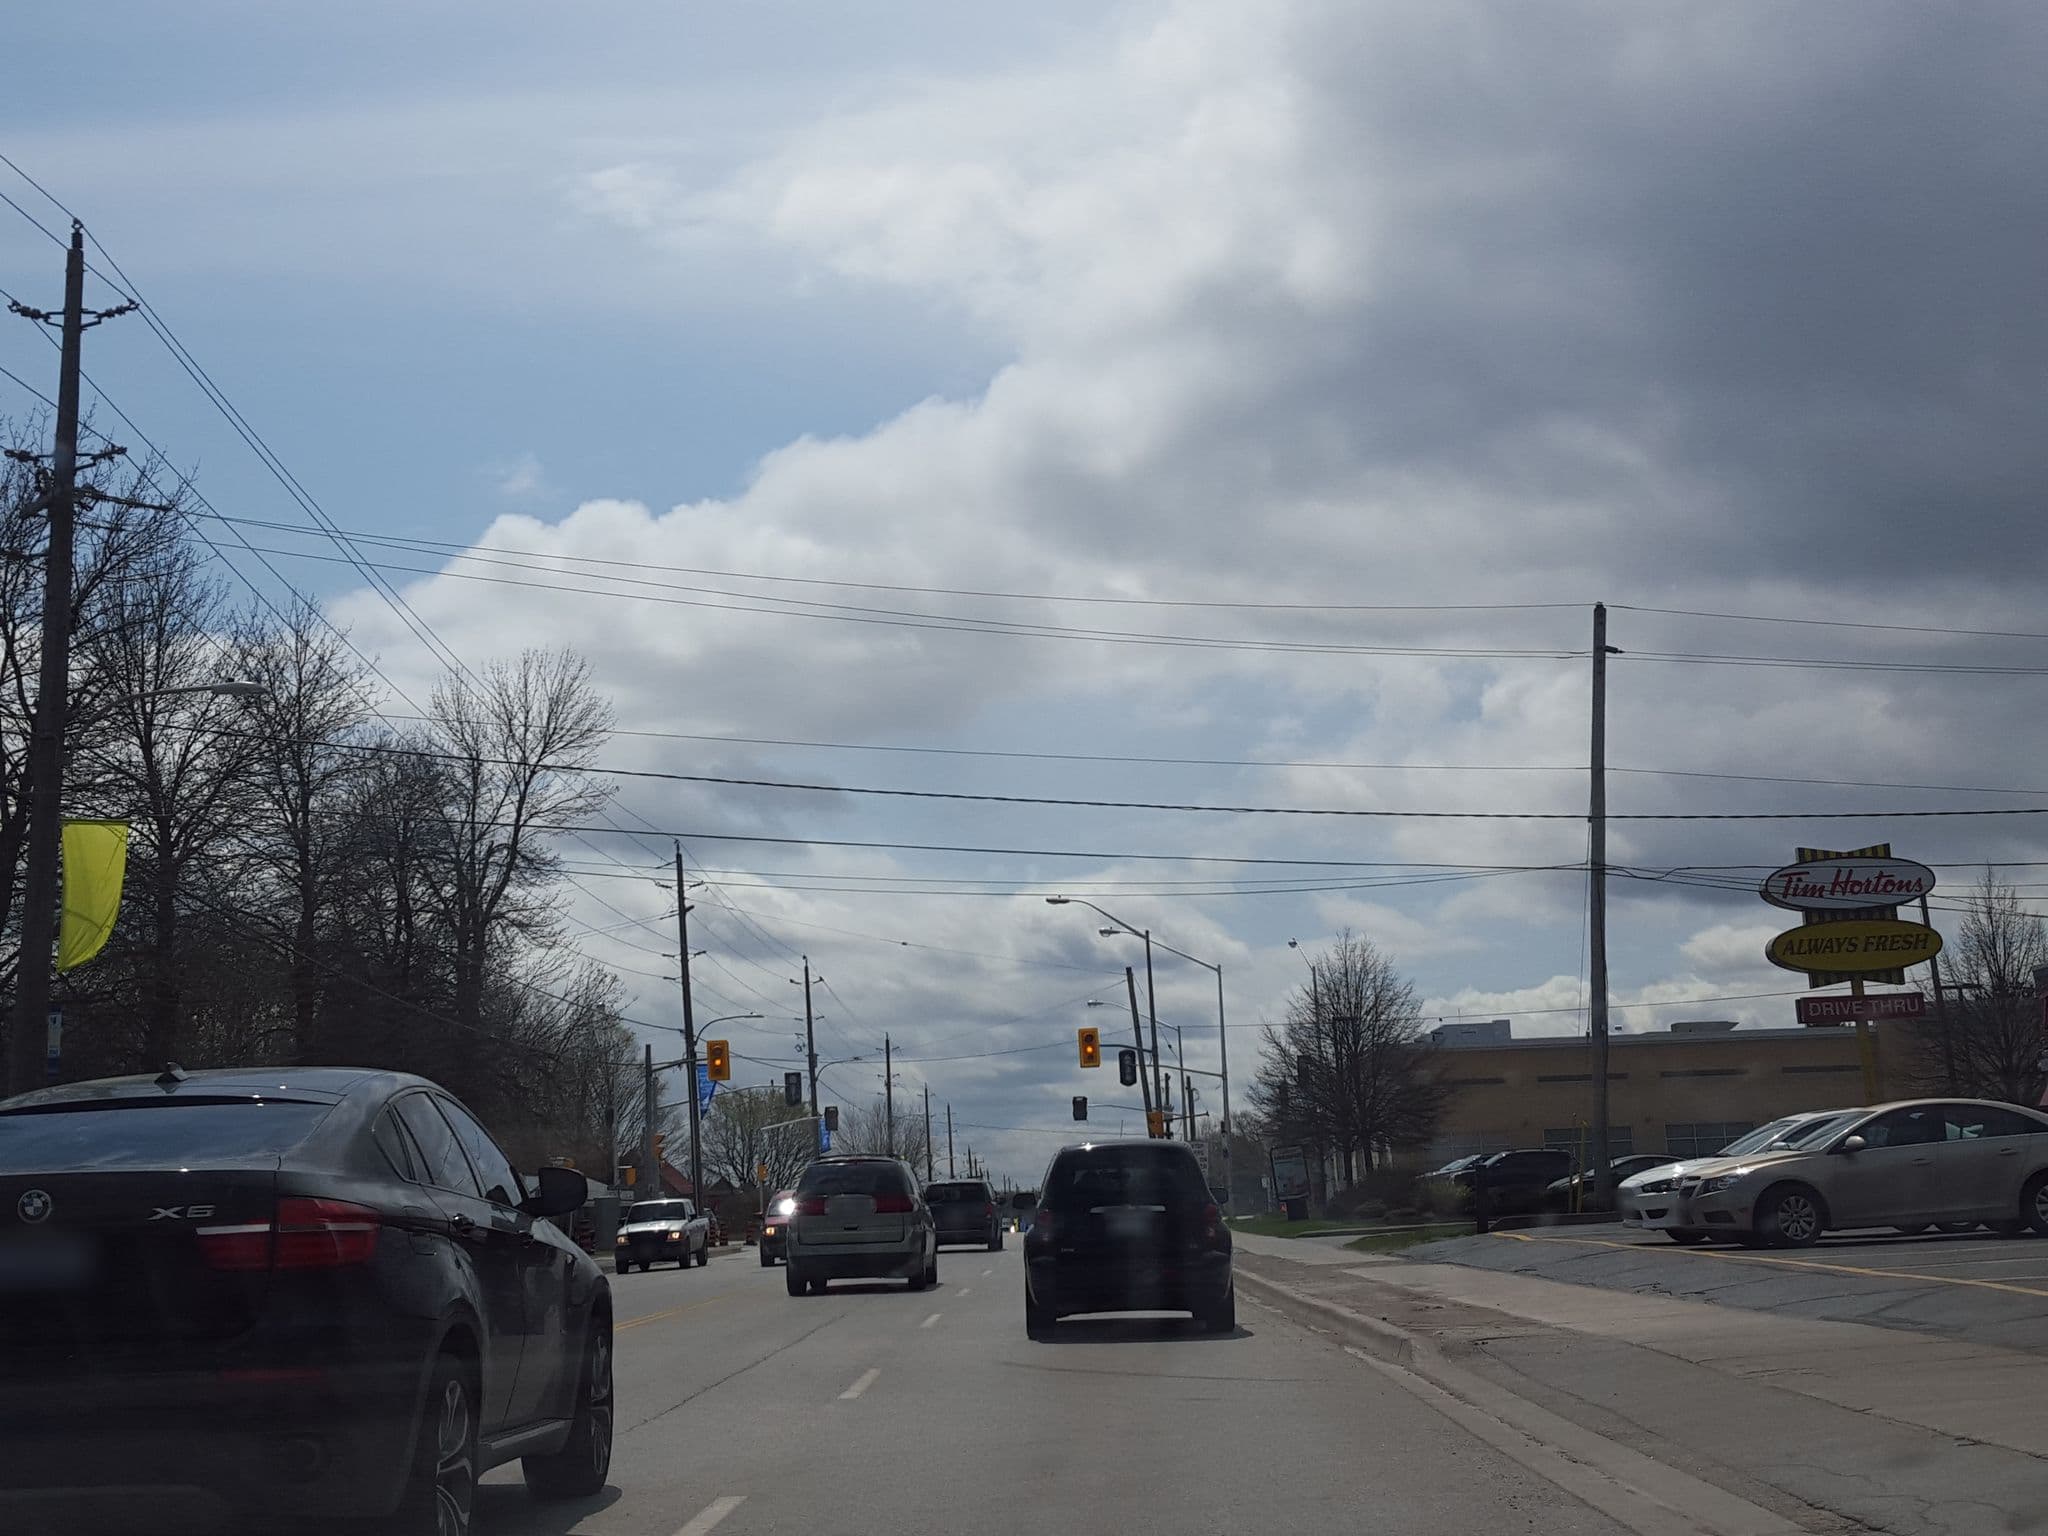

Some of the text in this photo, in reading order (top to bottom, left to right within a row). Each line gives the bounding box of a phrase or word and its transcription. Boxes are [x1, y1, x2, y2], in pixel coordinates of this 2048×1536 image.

[1778, 867, 1923, 899] Tim Hortons
[1782, 933, 1930, 956] ALWAYS FRESH
[1808, 998, 1920, 1017] DRIVE THRU
[146, 1204, 217, 1221] X6
